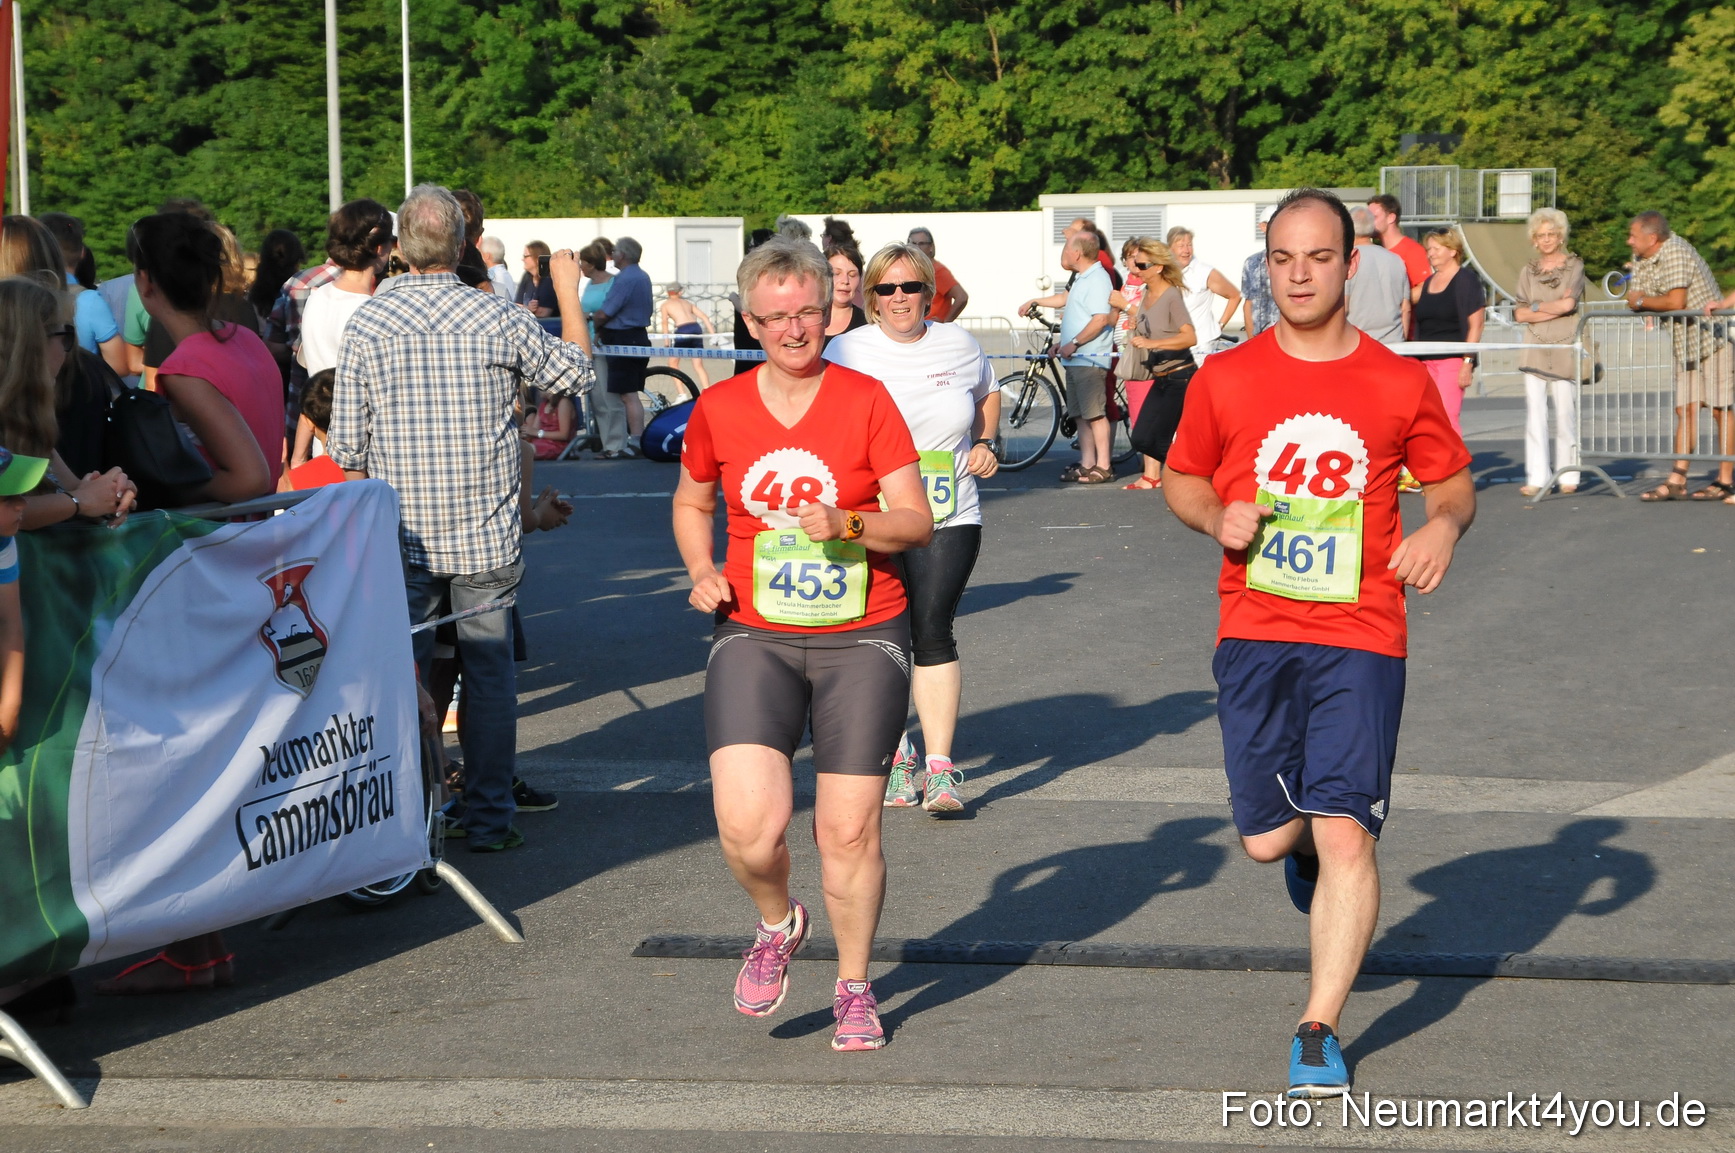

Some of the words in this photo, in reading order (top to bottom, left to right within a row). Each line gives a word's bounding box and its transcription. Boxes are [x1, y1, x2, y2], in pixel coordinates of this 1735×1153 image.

[1261, 530, 1336, 575] 461
[768, 561, 847, 601] 453
[1271, 580, 1313, 591] Hammerbacher
[1283, 573, 1297, 581] Timo
[779, 609, 820, 617] Hammerbacher
[234, 759, 395, 872] Lammsbräu
